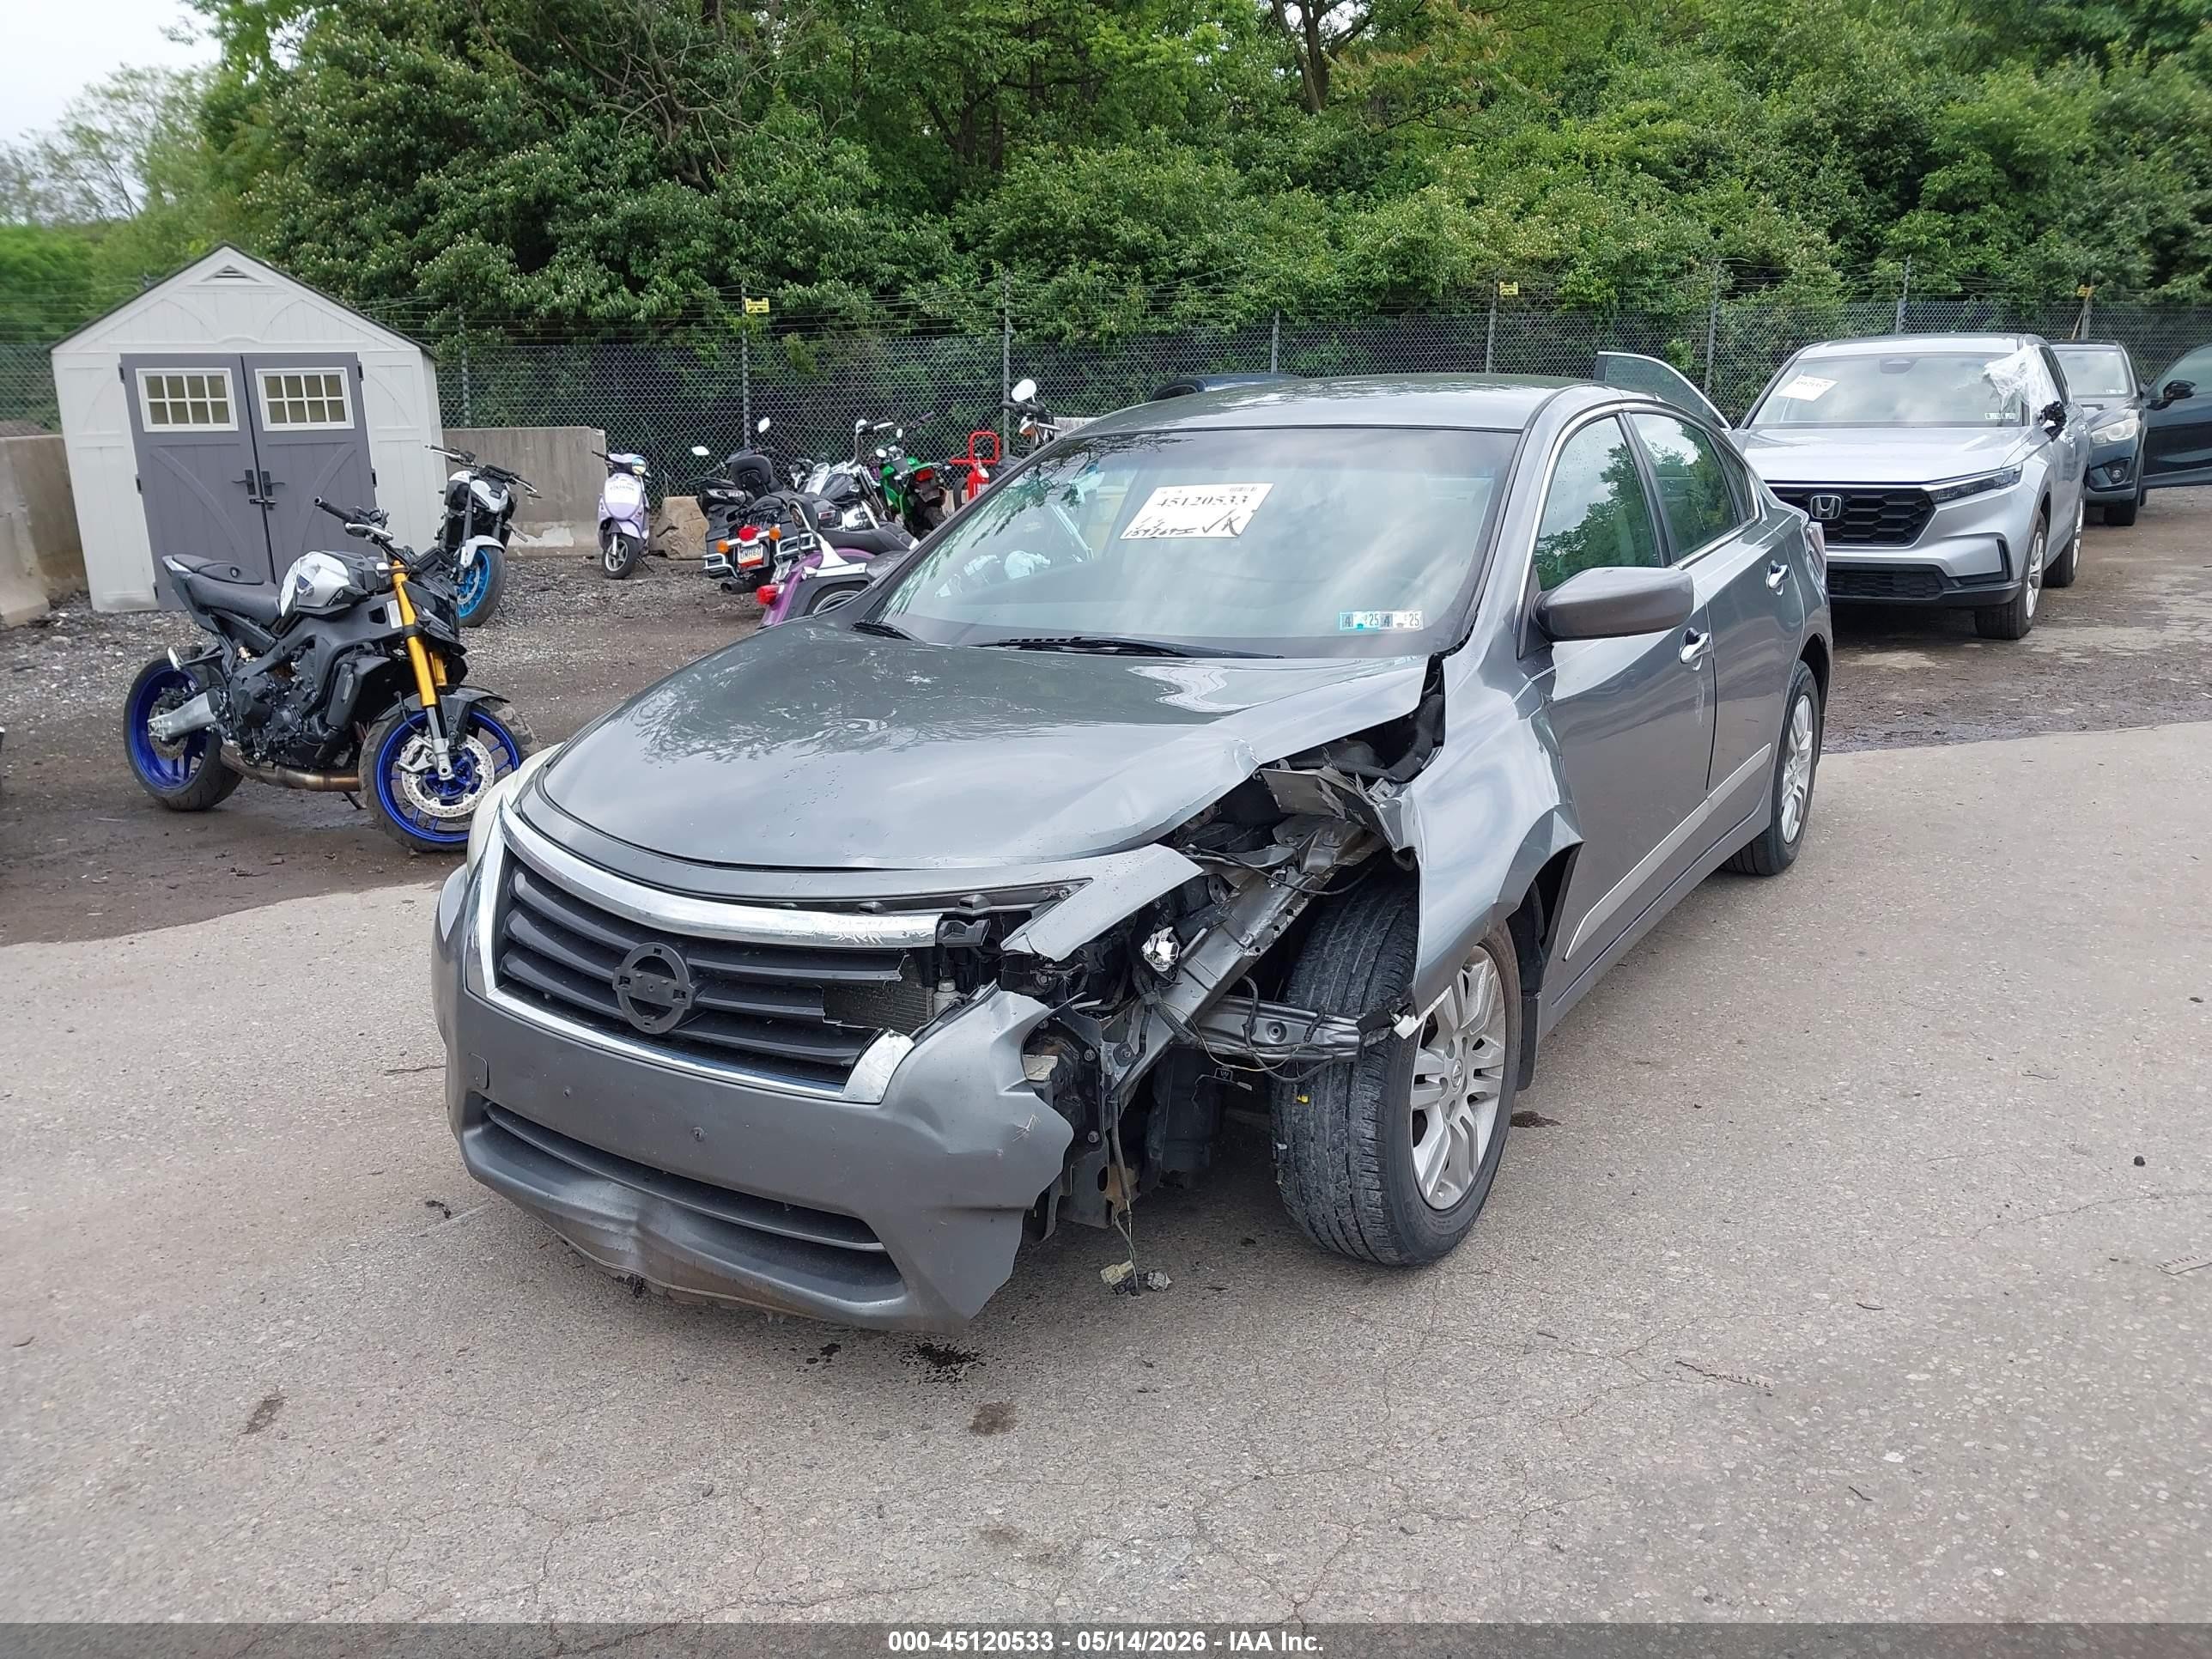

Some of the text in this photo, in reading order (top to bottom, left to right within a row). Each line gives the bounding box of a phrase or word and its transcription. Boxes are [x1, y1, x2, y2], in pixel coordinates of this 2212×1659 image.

[1155, 495, 1249, 507] 45120533
[1369, 613, 1380, 626] 25
[1409, 613, 1419, 627] 25
